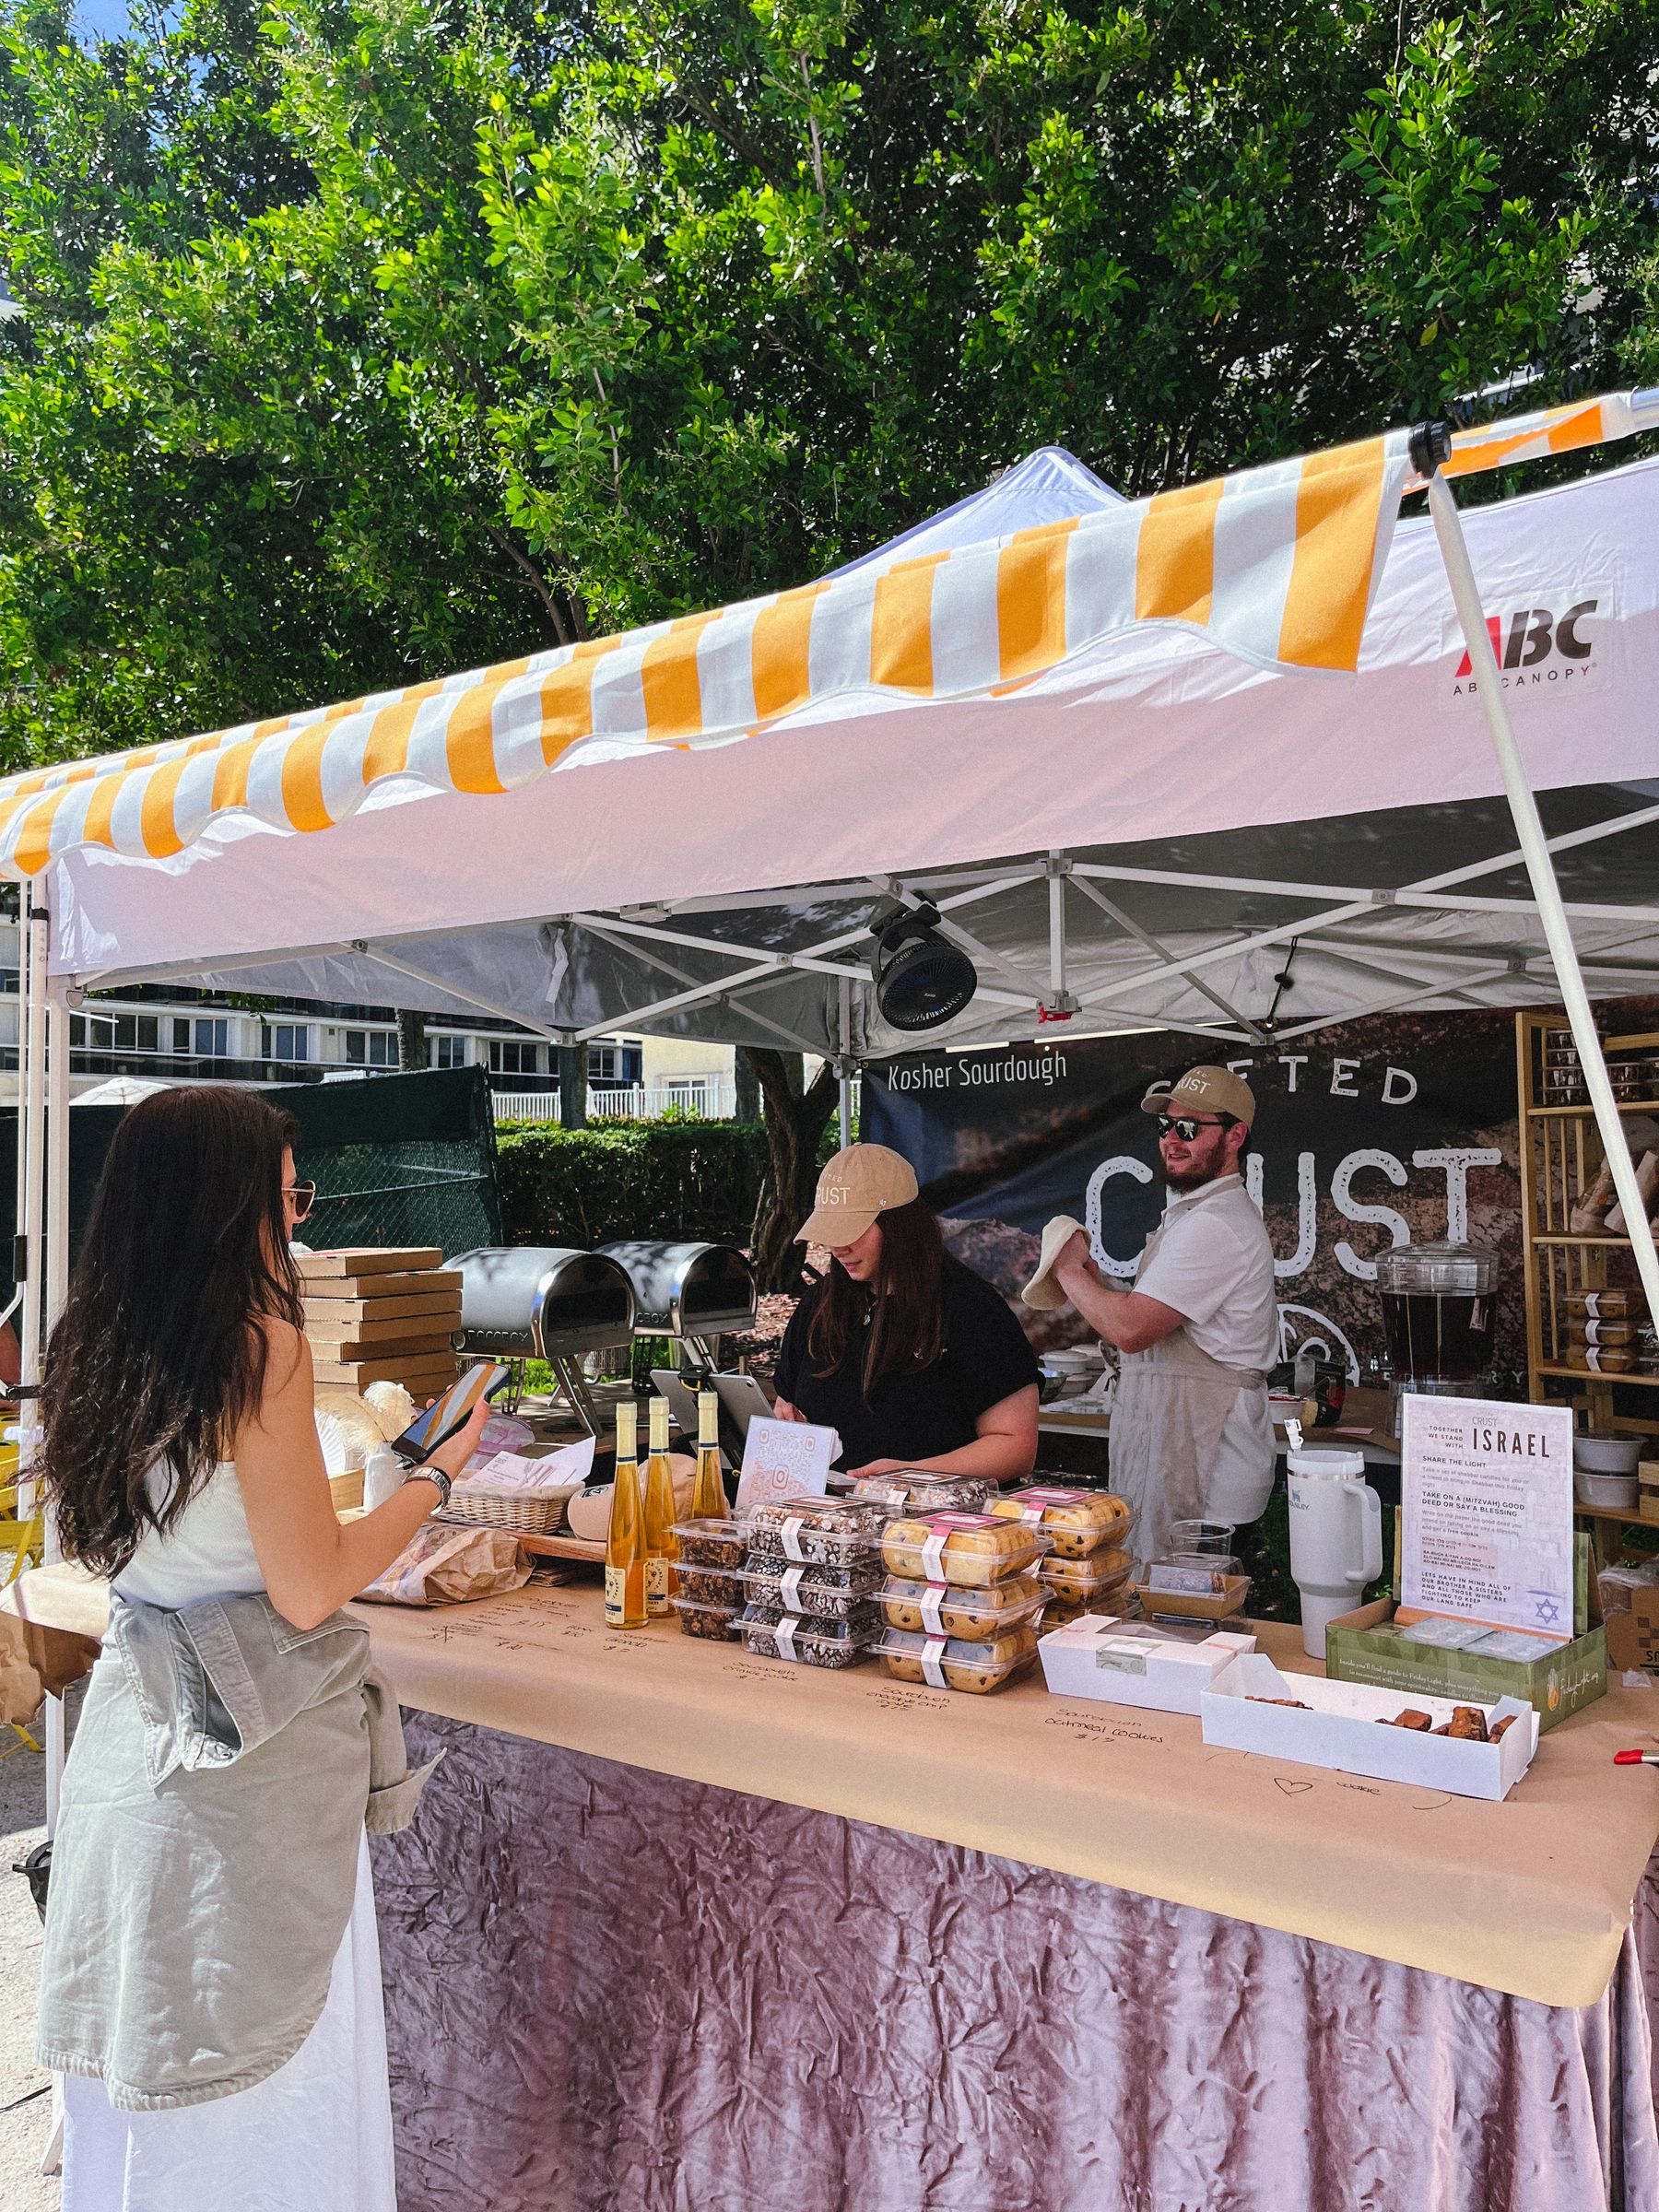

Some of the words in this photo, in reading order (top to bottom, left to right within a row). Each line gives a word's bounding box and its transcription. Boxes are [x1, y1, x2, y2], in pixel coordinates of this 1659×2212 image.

[1453, 682, 1478, 696] AB
[888, 1063, 953, 1091] Kosher
[959, 1051, 1067, 1086] Sourdough
[816, 1186, 851, 1206] RUST
[1085, 1147, 1502, 1280] CUST
[1429, 1425, 1463, 1434] TOGETHER
[1445, 1441, 1464, 1450] WITH
[1473, 1428, 1550, 1458] ISRAEL
[1422, 1455, 1446, 1464] SHARE
[1456, 1502, 1471, 1511] SAY
[1479, 1506, 1518, 1517] BLESSING
[1502, 1501, 1525, 1511] GOOD
[1438, 1572, 1456, 1582] HAVE
[1437, 1580, 1466, 1590] BROTHER
[1476, 1587, 1503, 1596] SISTERS
[1452, 1588, 1472, 1597] THOSE
[1421, 1589, 1452, 1599] FIGHTING
[1409, 1672, 1427, 1683] Friday
